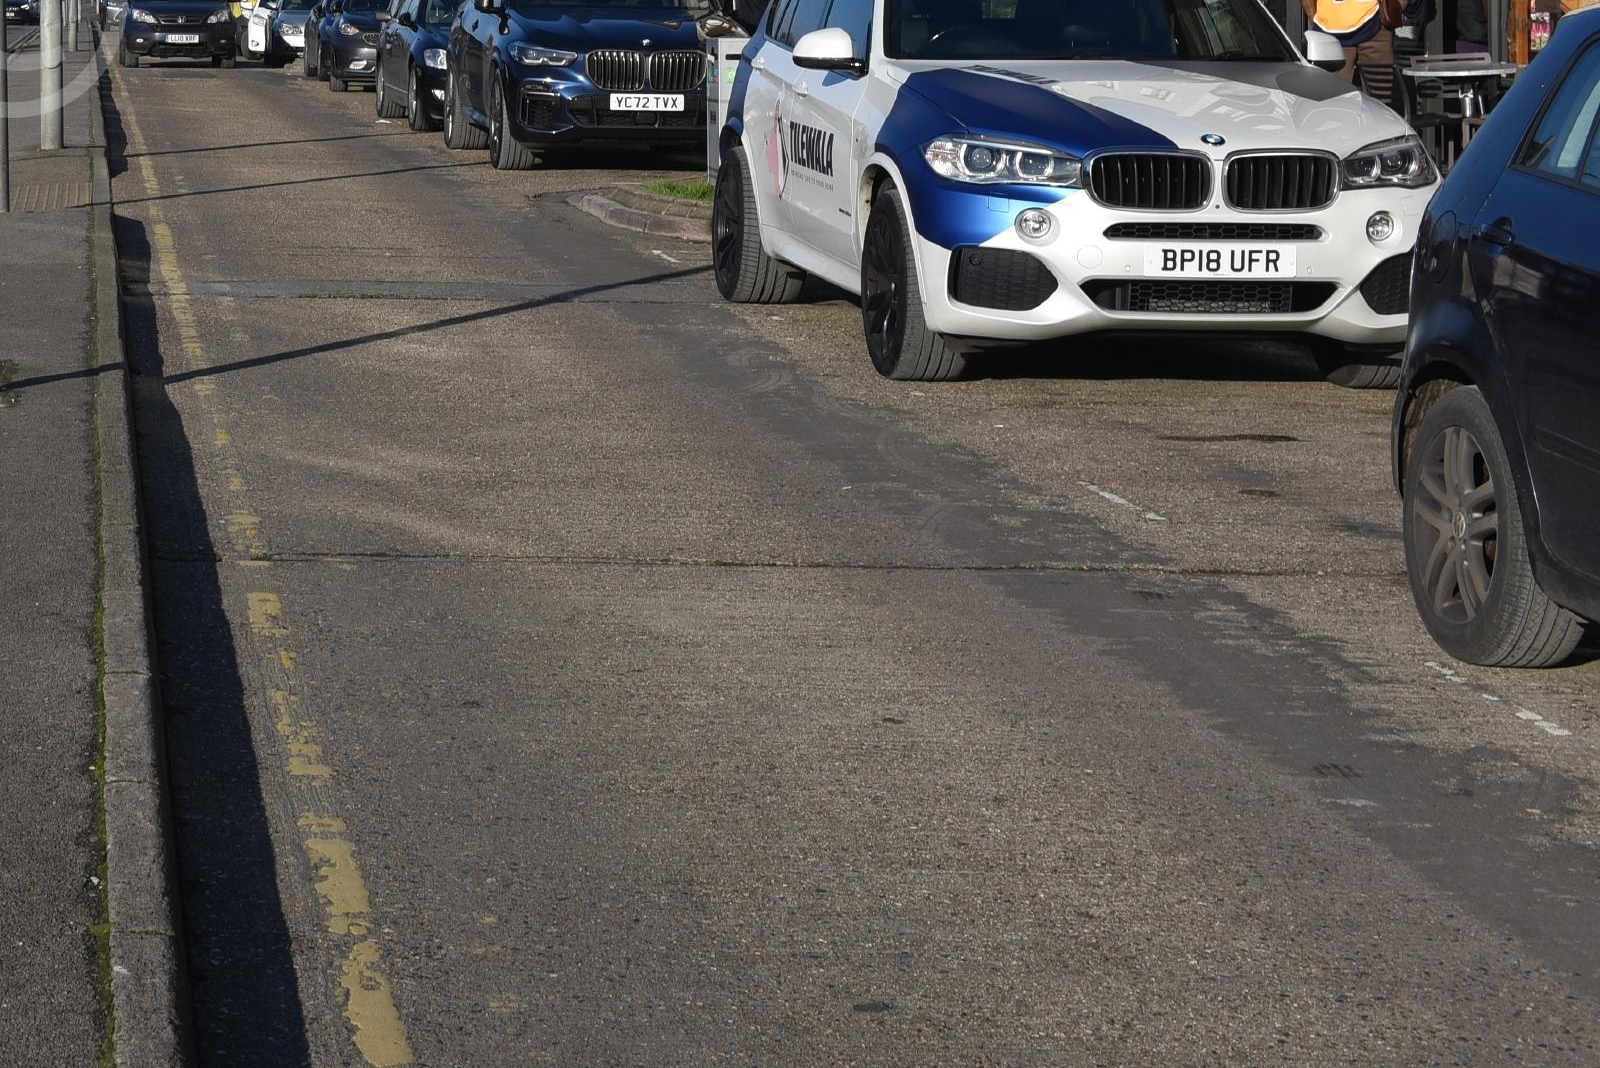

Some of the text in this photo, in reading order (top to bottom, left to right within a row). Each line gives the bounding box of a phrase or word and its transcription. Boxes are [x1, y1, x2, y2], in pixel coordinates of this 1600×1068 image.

[616, 97, 678, 109] YC72 TVX
[790, 120, 834, 178] TILEWALA
[1161, 248, 1281, 273] BP18 UFR
